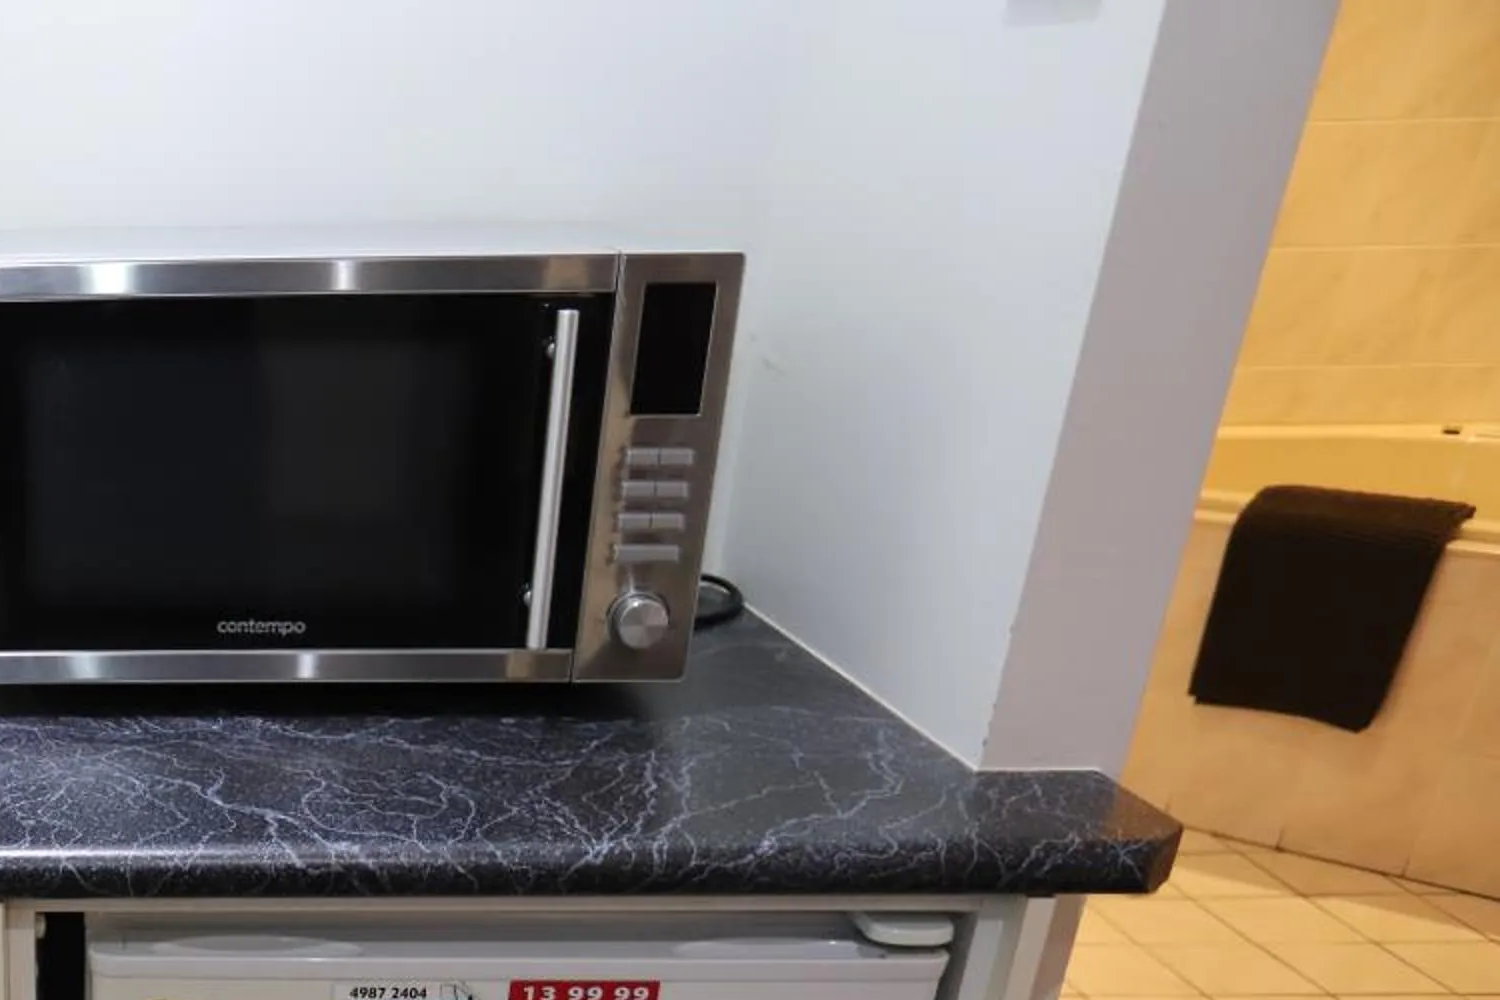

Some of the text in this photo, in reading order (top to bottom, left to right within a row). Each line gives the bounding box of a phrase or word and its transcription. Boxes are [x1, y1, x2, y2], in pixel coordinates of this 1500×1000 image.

[217, 619, 306, 635] contempo
[350, 986, 427, 999] 4987 2404
